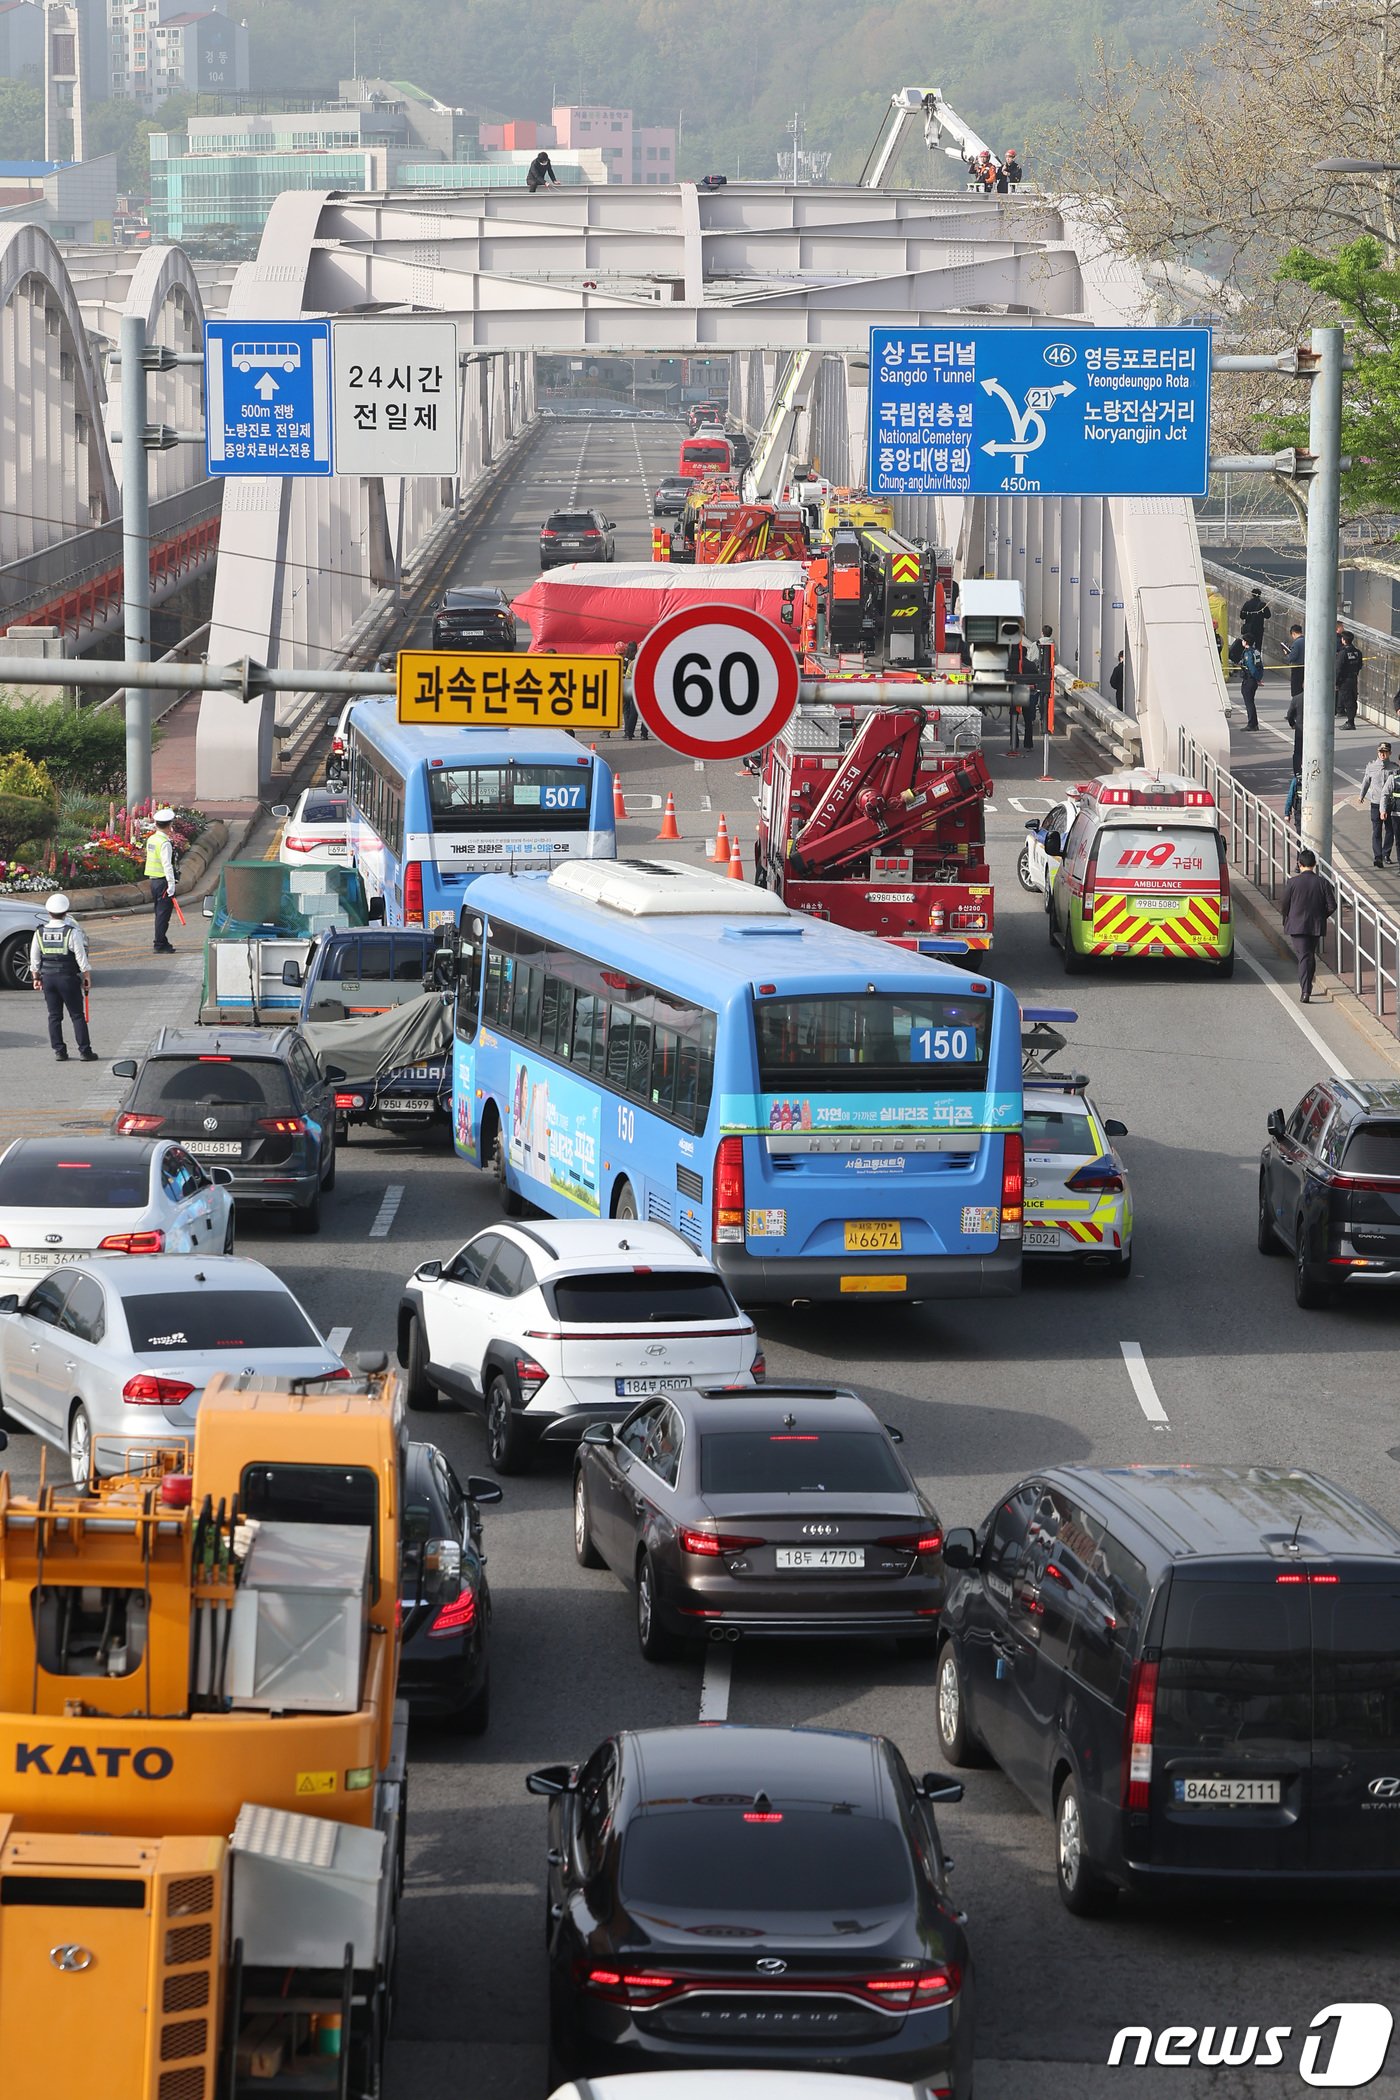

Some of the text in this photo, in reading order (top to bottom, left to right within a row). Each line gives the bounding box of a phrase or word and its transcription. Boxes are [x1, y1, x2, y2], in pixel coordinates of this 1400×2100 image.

[206, 50, 228, 64] 경동
[209, 71, 224, 81] 104
[882, 341, 976, 366] 상도터널
[1048, 347, 1071, 363] 46
[1084, 348, 1196, 371] 영등포로터리
[349, 365, 442, 393] 24시간
[880, 367, 975, 386] Sangdo Tunnel
[1087, 373, 1162, 391] Yeongdeungpo
[1032, 391, 1049, 406] 21
[241, 404, 294, 419] 500m 전방
[353, 403, 437, 431] 전일제
[879, 402, 973, 427] 국립현충원
[1084, 400, 1195, 423] 노량진삼거리
[224, 422, 310, 438] 노량진로 전일제
[879, 428, 972, 447] National Cemetery
[1084, 425, 1187, 443] Noryangjin Jct
[224, 442, 311, 458] 중앙차로버스전용
[878, 447, 971, 473] 중앙대(병원)
[1000, 477, 1040, 491] 450m
[414, 666, 608, 717] 과속단속장비
[672, 651, 760, 718] 60
[545, 787, 581, 807] 507
[450, 844, 476, 854] 가벼운
[477, 844, 503, 853] 질환은
[1115, 843, 1176, 868] 119
[1172, 858, 1203, 870] 구급대
[1134, 881, 1182, 889] AMBULANCE
[919, 1030, 968, 1059] 150
[390, 1067, 446, 1079] UNDAI
[405, 1101, 430, 1109] 4599
[617, 1105, 635, 1144] 150
[852, 1112, 877, 1121] 가까운
[879, 1107, 928, 1121] 실내건조
[932, 1105, 973, 1126] 피죤
[808, 1138, 943, 1151] HYUNDAI
[874, 1222, 887, 1231] 70
[659, 1379, 688, 1391] 8507
[784, 1551, 857, 1565] 18두 4770
[15, 1743, 174, 1781] KATO
[1187, 1783, 1275, 1800] 846러 2111
